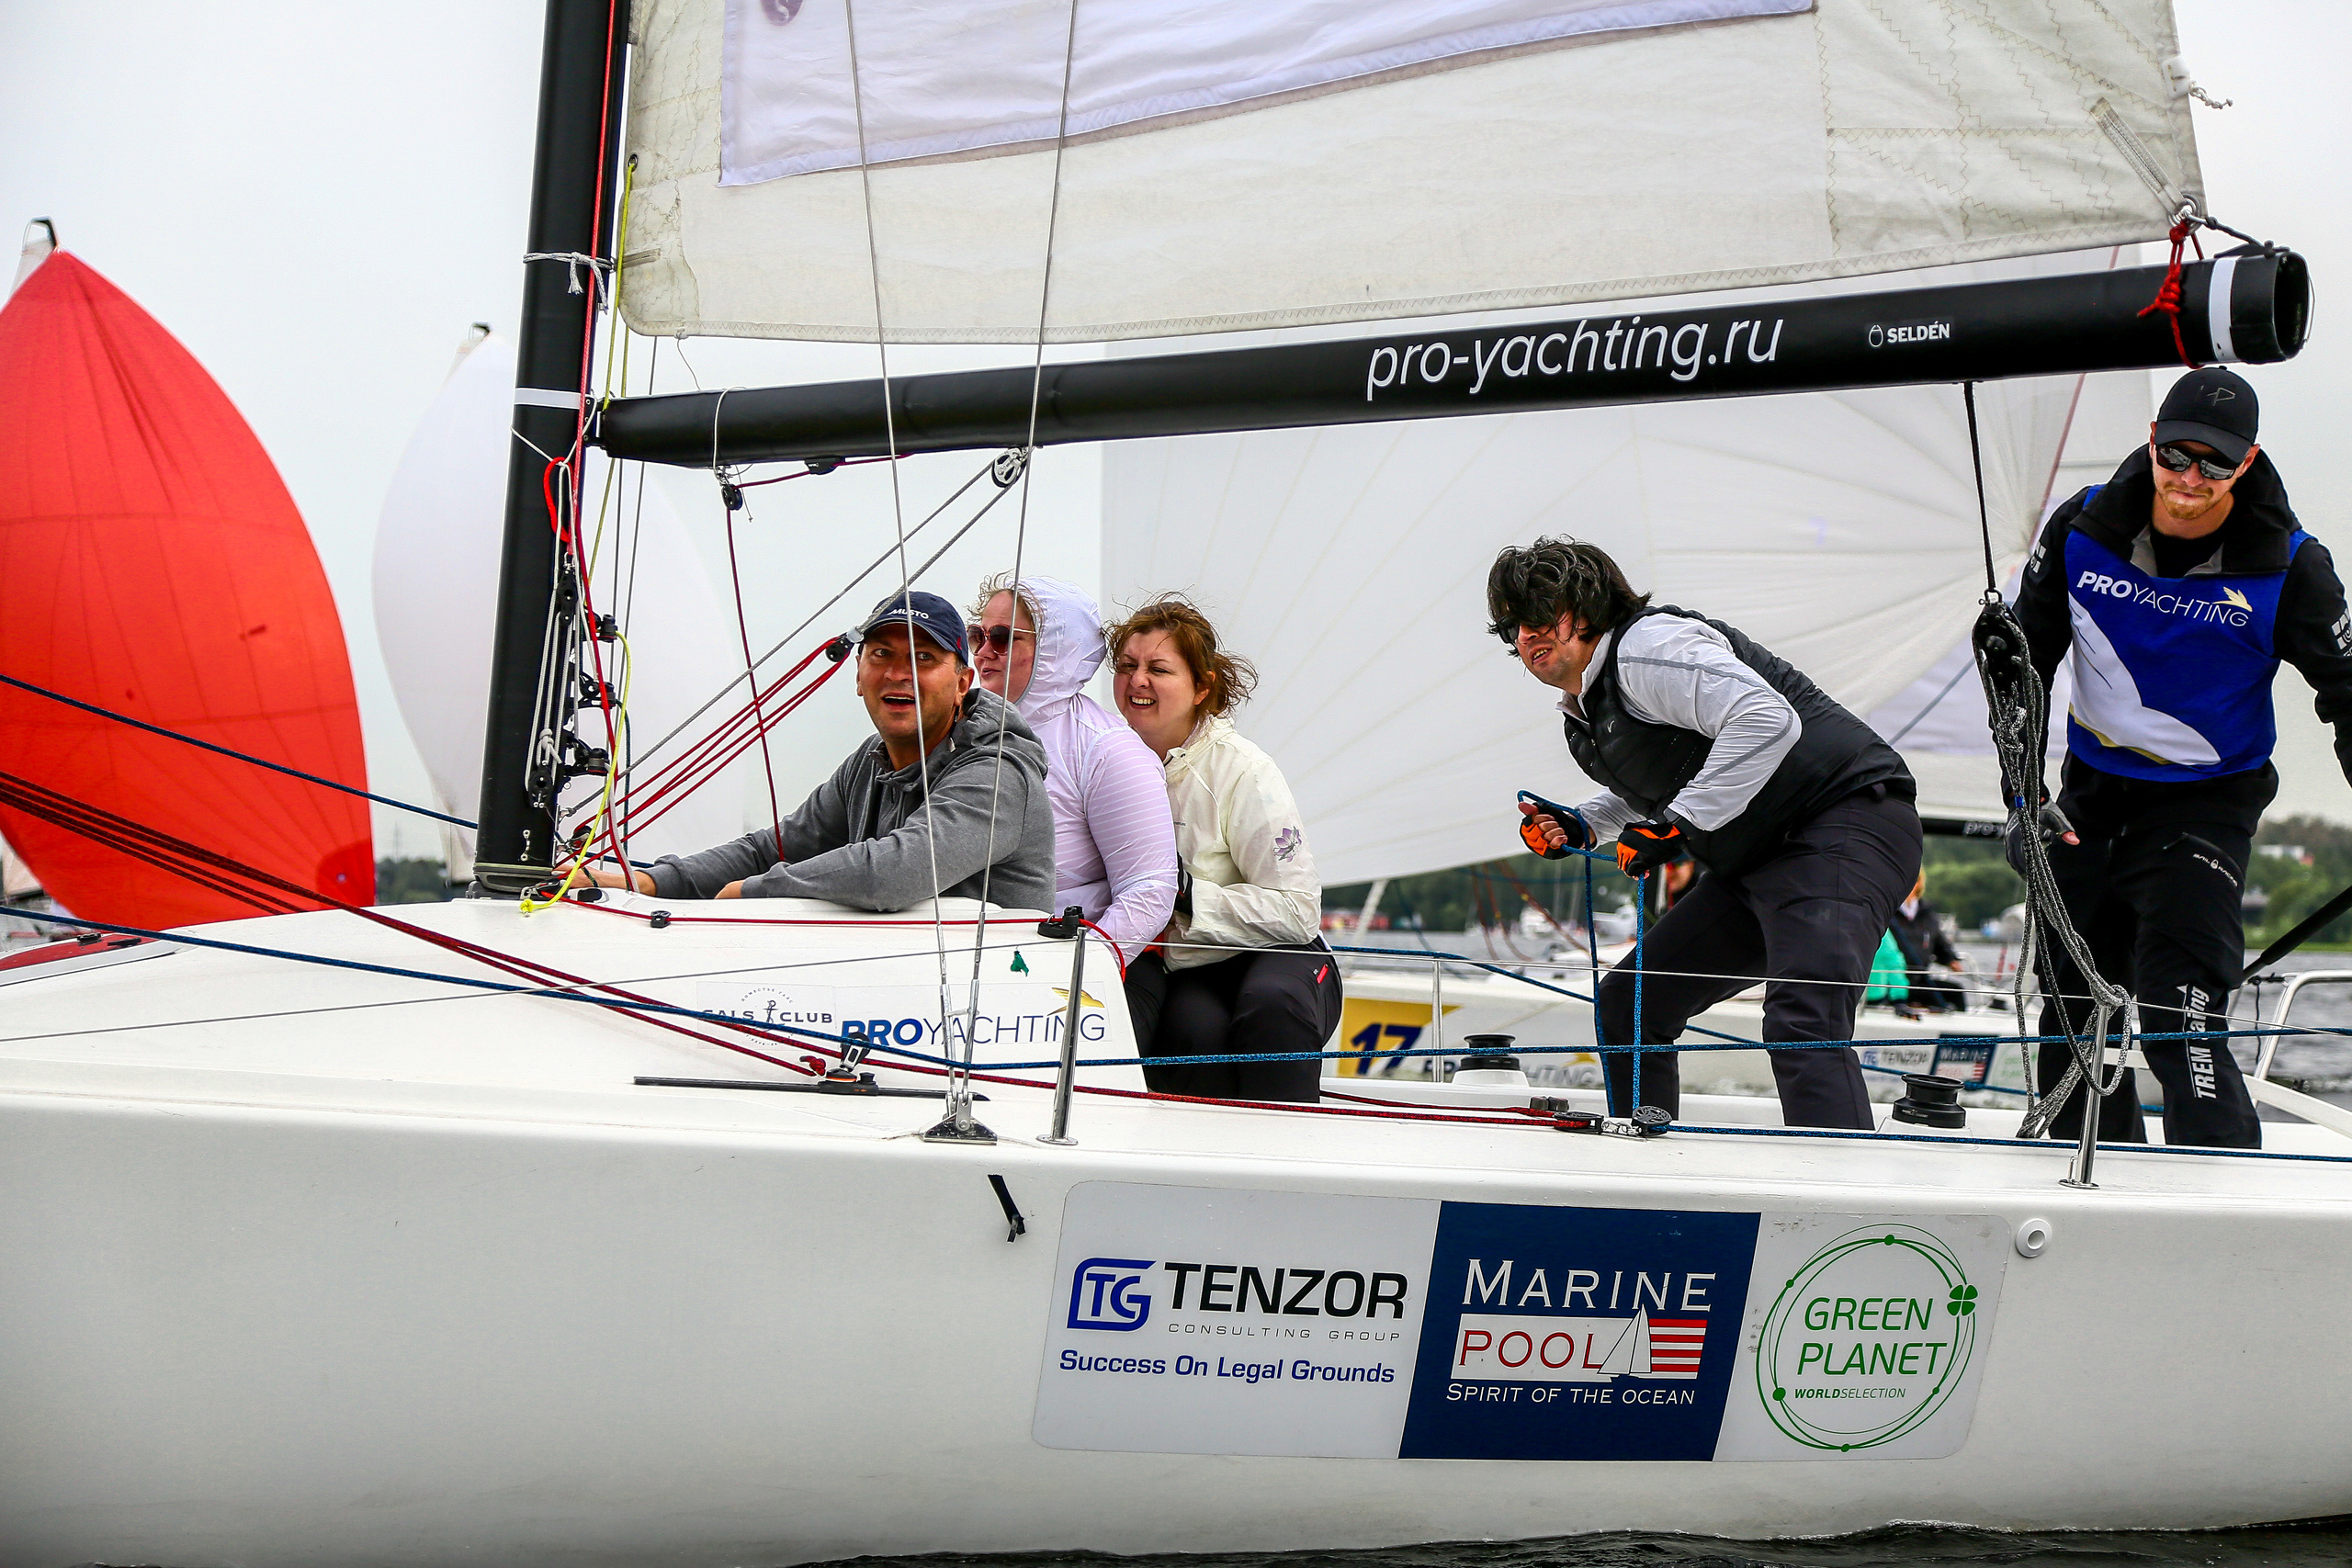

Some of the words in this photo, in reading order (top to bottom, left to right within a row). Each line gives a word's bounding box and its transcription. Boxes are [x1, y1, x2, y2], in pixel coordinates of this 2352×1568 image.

[1887, 320, 1951, 344] SELDÉN
[1366, 315, 1783, 401] pro-yachting.ru
[888, 608, 930, 619] MUSTO
[2076, 570, 2249, 626] PROYACHTING
[779, 1011, 833, 1024] CLUB
[1350, 1022, 1423, 1077] 17
[2188, 1045, 2217, 1099] TREM
[1164, 1261, 1408, 1319] TENZOR
[1462, 1258, 1716, 1312] MARINE
[1804, 1297, 1934, 1331] GREEN
[1168, 1323, 1311, 1339] CONSULTING
[1328, 1330, 1401, 1342] GROUP
[1458, 1329, 1603, 1370] POOL
[1059, 1349, 1166, 1374] Success
[1175, 1355, 1208, 1377] On
[1216, 1357, 1283, 1383] Legal
[1291, 1359, 1396, 1382] Grounds
[1797, 1342, 1948, 1375] PLANET
[1446, 1383, 1523, 1403] SPIRIT
[1531, 1388, 1562, 1404] OF
[1570, 1388, 1614, 1404] THE
[1622, 1390, 1695, 1405] OCEAN
[1794, 1388, 1906, 1399] WORLDSELECTION
